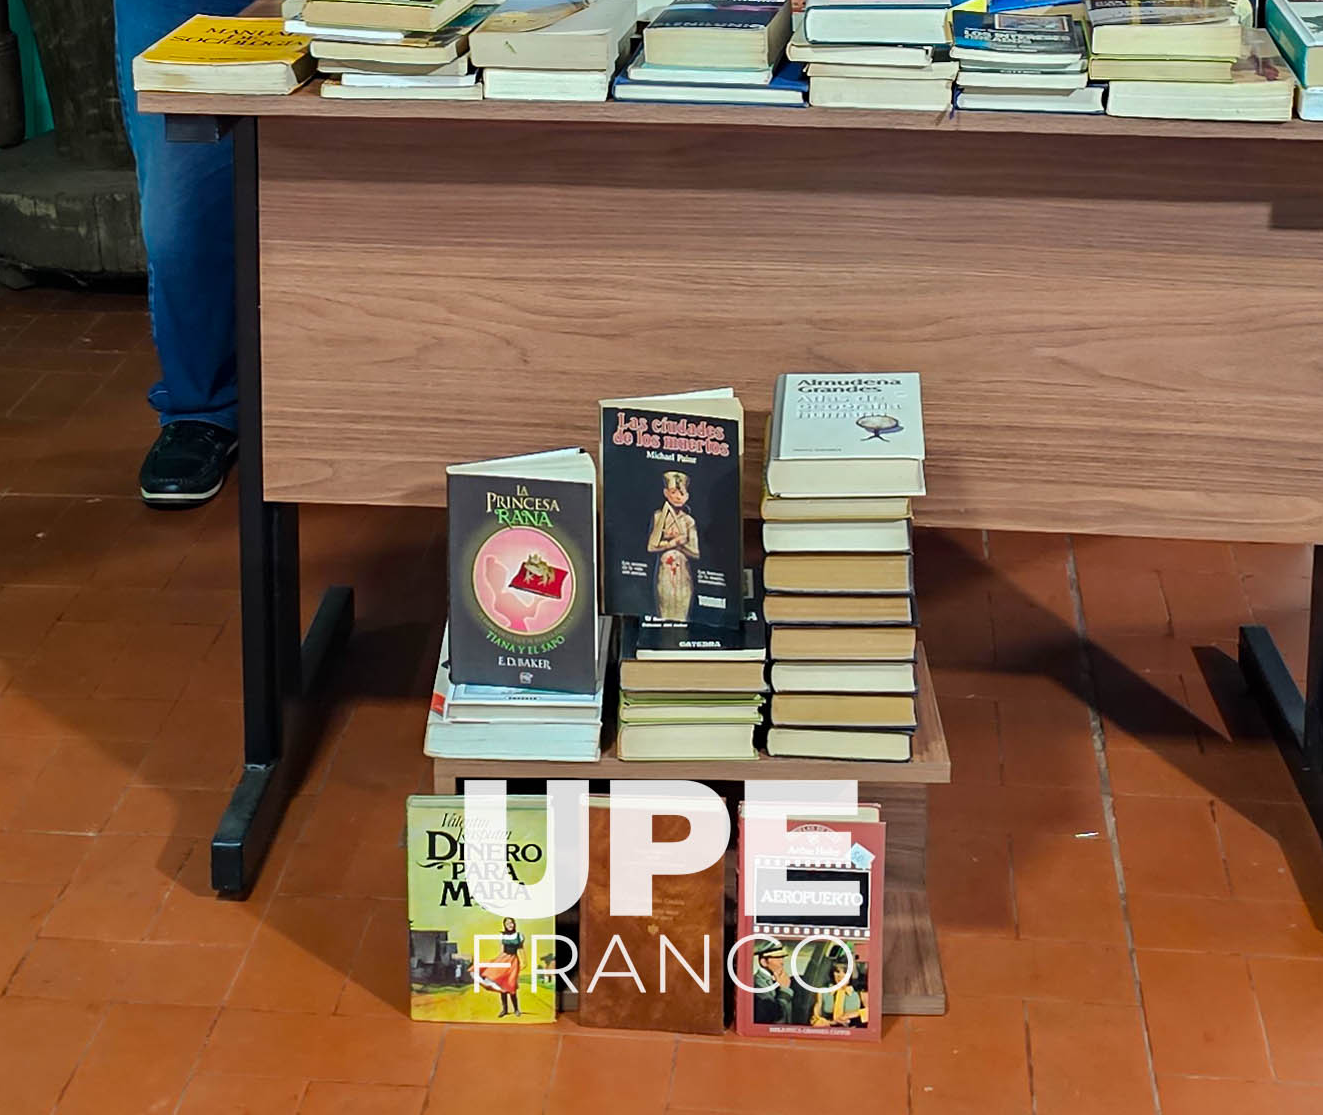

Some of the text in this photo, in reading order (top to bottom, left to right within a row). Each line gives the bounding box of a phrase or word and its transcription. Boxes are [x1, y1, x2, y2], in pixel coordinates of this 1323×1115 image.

[205, 27, 300, 37] MANUA
[617, 412, 726, 441] Las ciudades
[613, 429, 730, 457] de los muertos
[646, 451, 675, 461] Michael
[516, 484, 529, 496] LA
[486, 491, 560, 513] PRINCESA
[494, 508, 554, 529] RANA
[486, 630, 566, 655] TIANA Y EL SAPO
[426, 830, 542, 862] DINERO
[452, 862, 520, 881] PARA
[761, 890, 865, 906] AEROPUERTO
